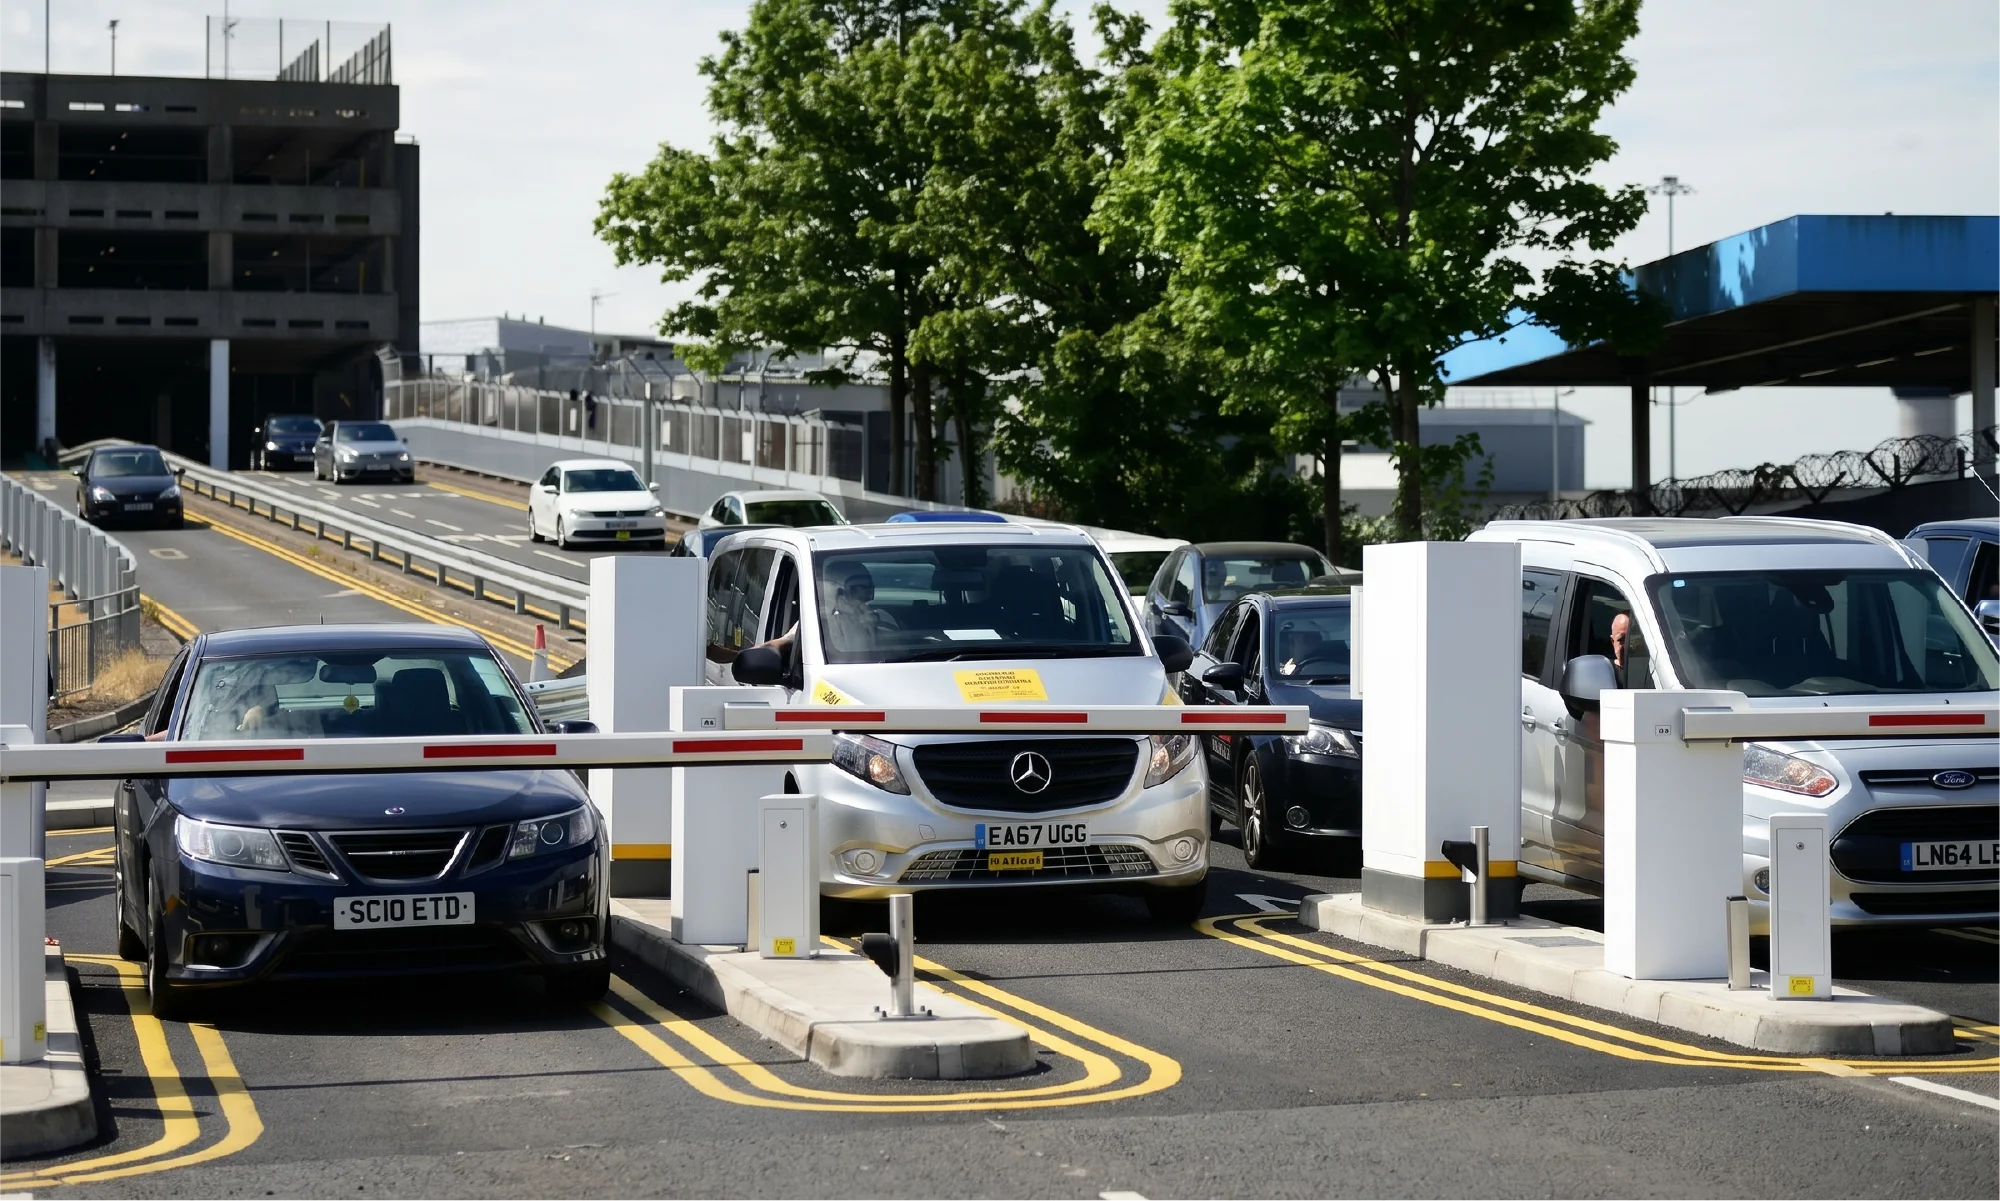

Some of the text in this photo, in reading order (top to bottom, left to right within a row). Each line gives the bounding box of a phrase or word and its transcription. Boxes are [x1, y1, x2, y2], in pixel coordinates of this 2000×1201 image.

[989, 824, 1087, 845] EA67 UGG
[1916, 844, 1972, 866] LN64
[349, 896, 460, 924] SC10 ETD
